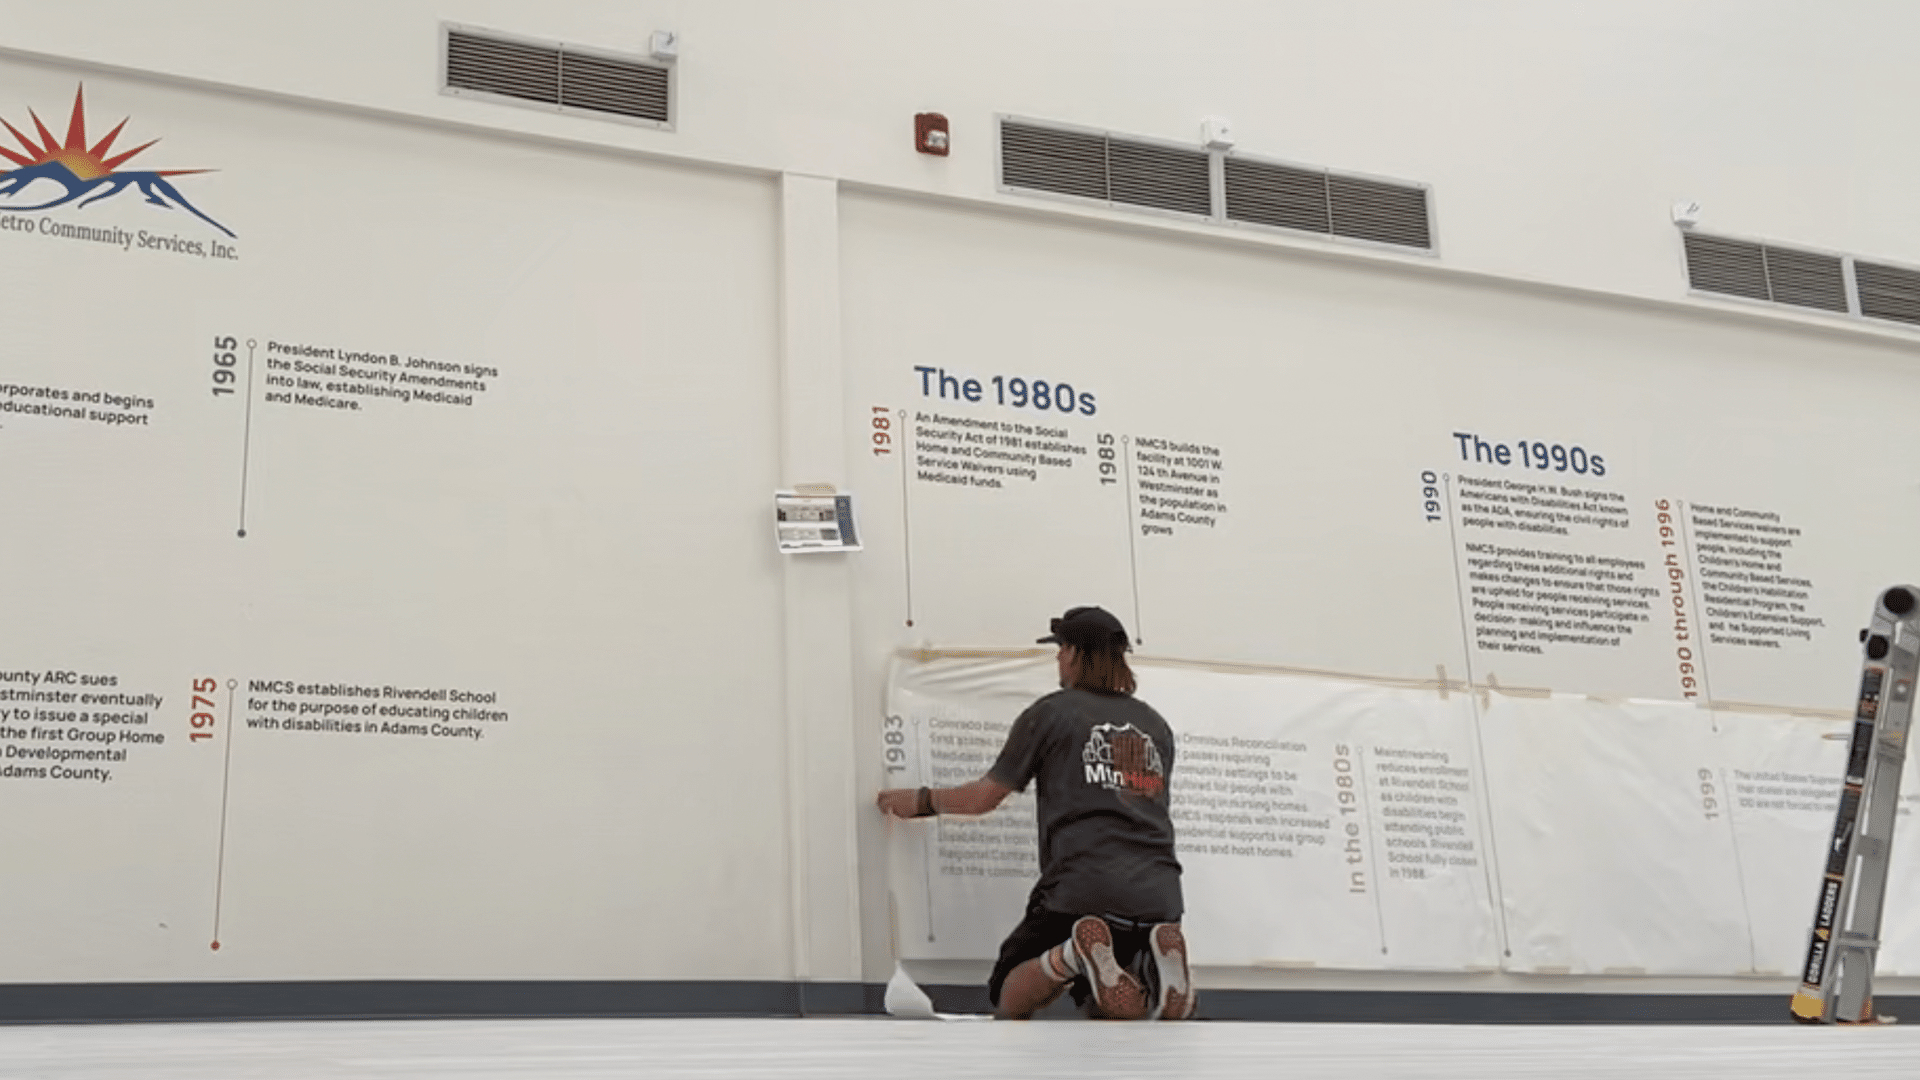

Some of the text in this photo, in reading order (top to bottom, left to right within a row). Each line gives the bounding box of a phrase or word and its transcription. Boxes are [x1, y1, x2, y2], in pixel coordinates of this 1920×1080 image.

[39, 217, 134, 251] Community
[137, 230, 207, 259] Services,
[211, 240, 239, 261] Inc.
[212, 336, 238, 396] 1965
[267, 341, 334, 358] President
[338, 348, 387, 364] Lyndon
[405, 356, 461, 372] Johnson
[464, 362, 498, 377] signs
[266, 357, 486, 390] the Social Security Amendments
[72, 391, 100, 402] and
[103, 392, 154, 408] begins
[265, 391, 360, 410] and Medicare.
[266, 373, 472, 405] into law, establishing Medicaid
[914, 365, 1096, 416] The 1980s
[89, 411, 148, 425] support
[872, 405, 891, 455] 1981
[915, 411, 1068, 438] An Amendment to the Social
[915, 426, 1087, 453] Security Act of 1981 establishes
[1134, 436, 1220, 455] NMCS builds the
[915, 440, 1072, 467] Home and Community Based
[1096, 433, 1117, 485] 1985
[1136, 450, 1171, 466] facility
[1174, 455, 1183, 464] at
[1187, 456, 1209, 467] 1001
[1453, 432, 1606, 476] The 1990s
[916, 454, 1036, 480] Service Waivers using
[917, 470, 1004, 488] Medicaid funds.
[1170, 468, 1207, 482] Avenue
[1209, 473, 1220, 483] in
[1138, 478, 1203, 495] Westminster
[1420, 471, 1442, 522] 1990
[1138, 493, 1226, 512] the population in
[1140, 507, 1216, 528] Adams County
[1141, 525, 1173, 535] grows
[1655, 499, 1697, 698] 1990 through 1996
[44, 670, 76, 683] ARC
[80, 675, 117, 685] sues
[81, 692, 162, 710] eventually
[248, 678, 496, 703] NMCS establishes Rivendell School
[13, 707, 148, 726] to issue a special
[190, 677, 217, 742] 1975
[247, 697, 508, 721] for the purpose of educating children
[0, 724, 164, 745] the first Group Home
[246, 716, 484, 740] with disabilities in Adams County.
[6, 745, 126, 762] Developmental
[885, 715, 906, 774] 1983
[50, 765, 112, 783] County.
[1697, 768, 1718, 821] 1999
[1333, 744, 1366, 893] In the 1980s
